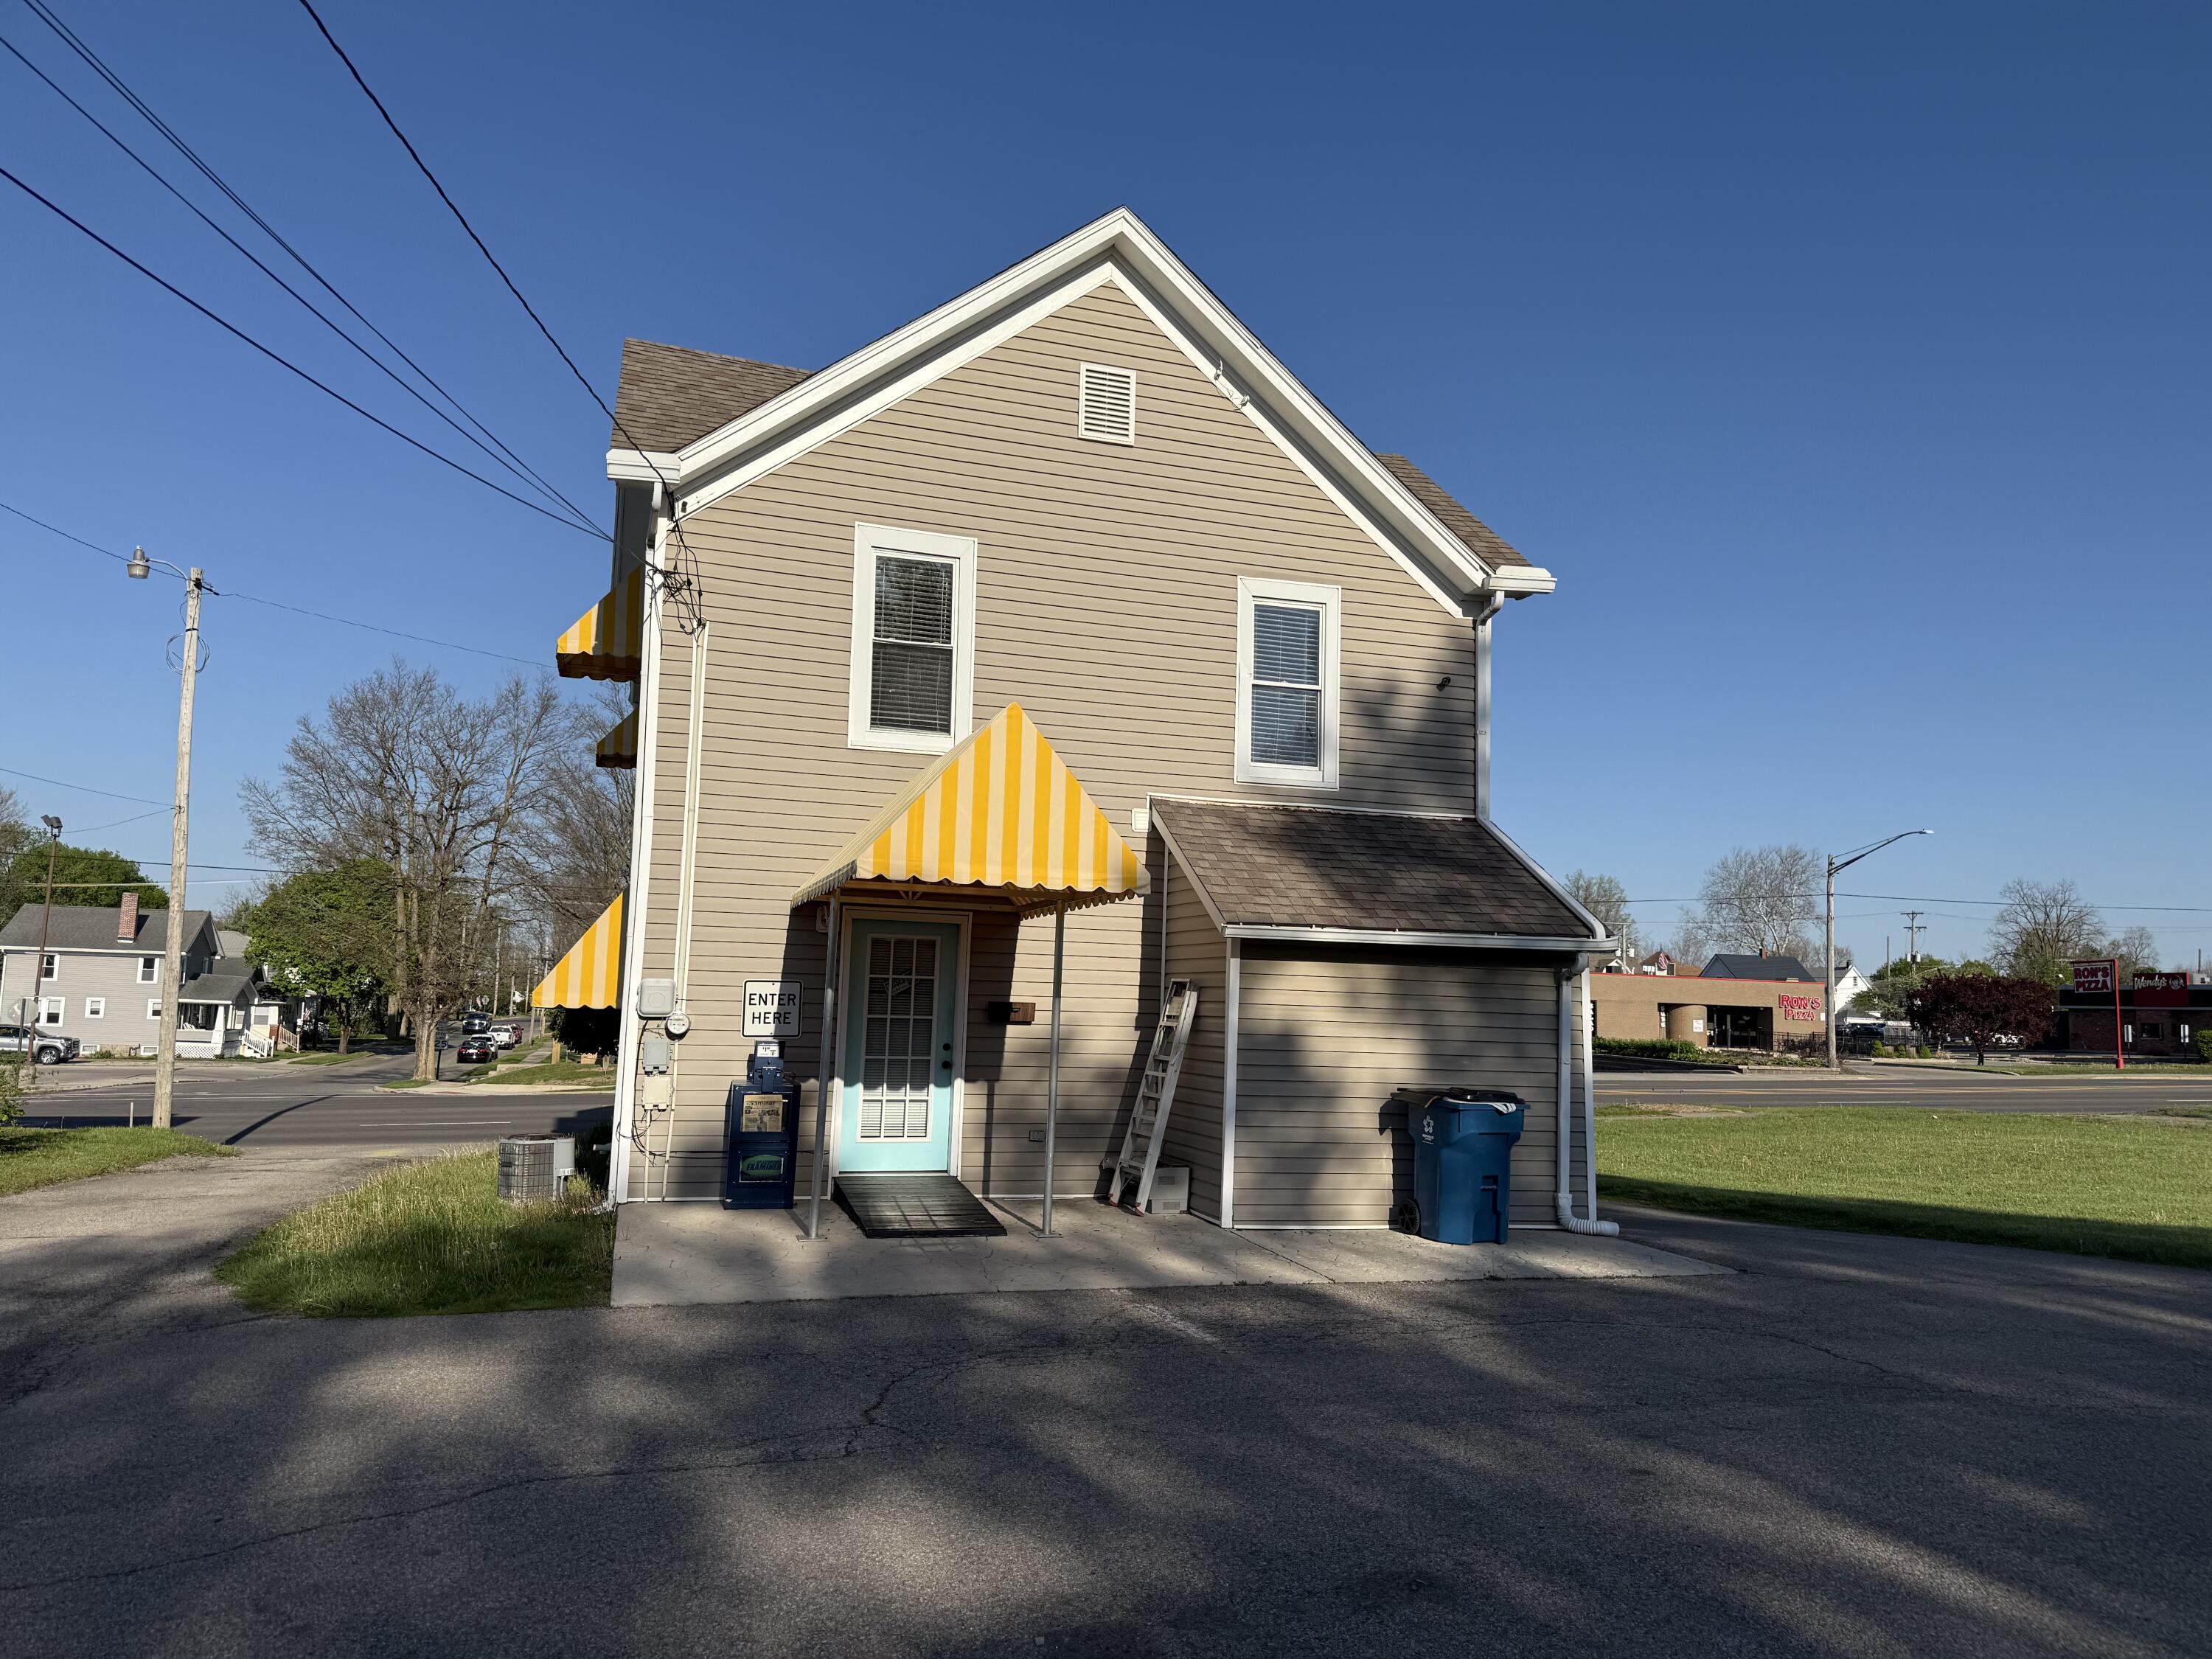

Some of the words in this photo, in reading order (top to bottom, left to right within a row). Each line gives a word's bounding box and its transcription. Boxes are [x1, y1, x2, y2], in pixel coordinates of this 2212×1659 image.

[2074, 967, 2110, 979] RON'S
[2076, 979, 2110, 992] PIZZA
[2135, 975, 2168, 990] Wendy's
[748, 993, 796, 1006] ENTER
[1780, 994, 1821, 1009] RON'S
[752, 1012, 791, 1025] HERE
[1786, 1009, 1815, 1020] PIZZA
